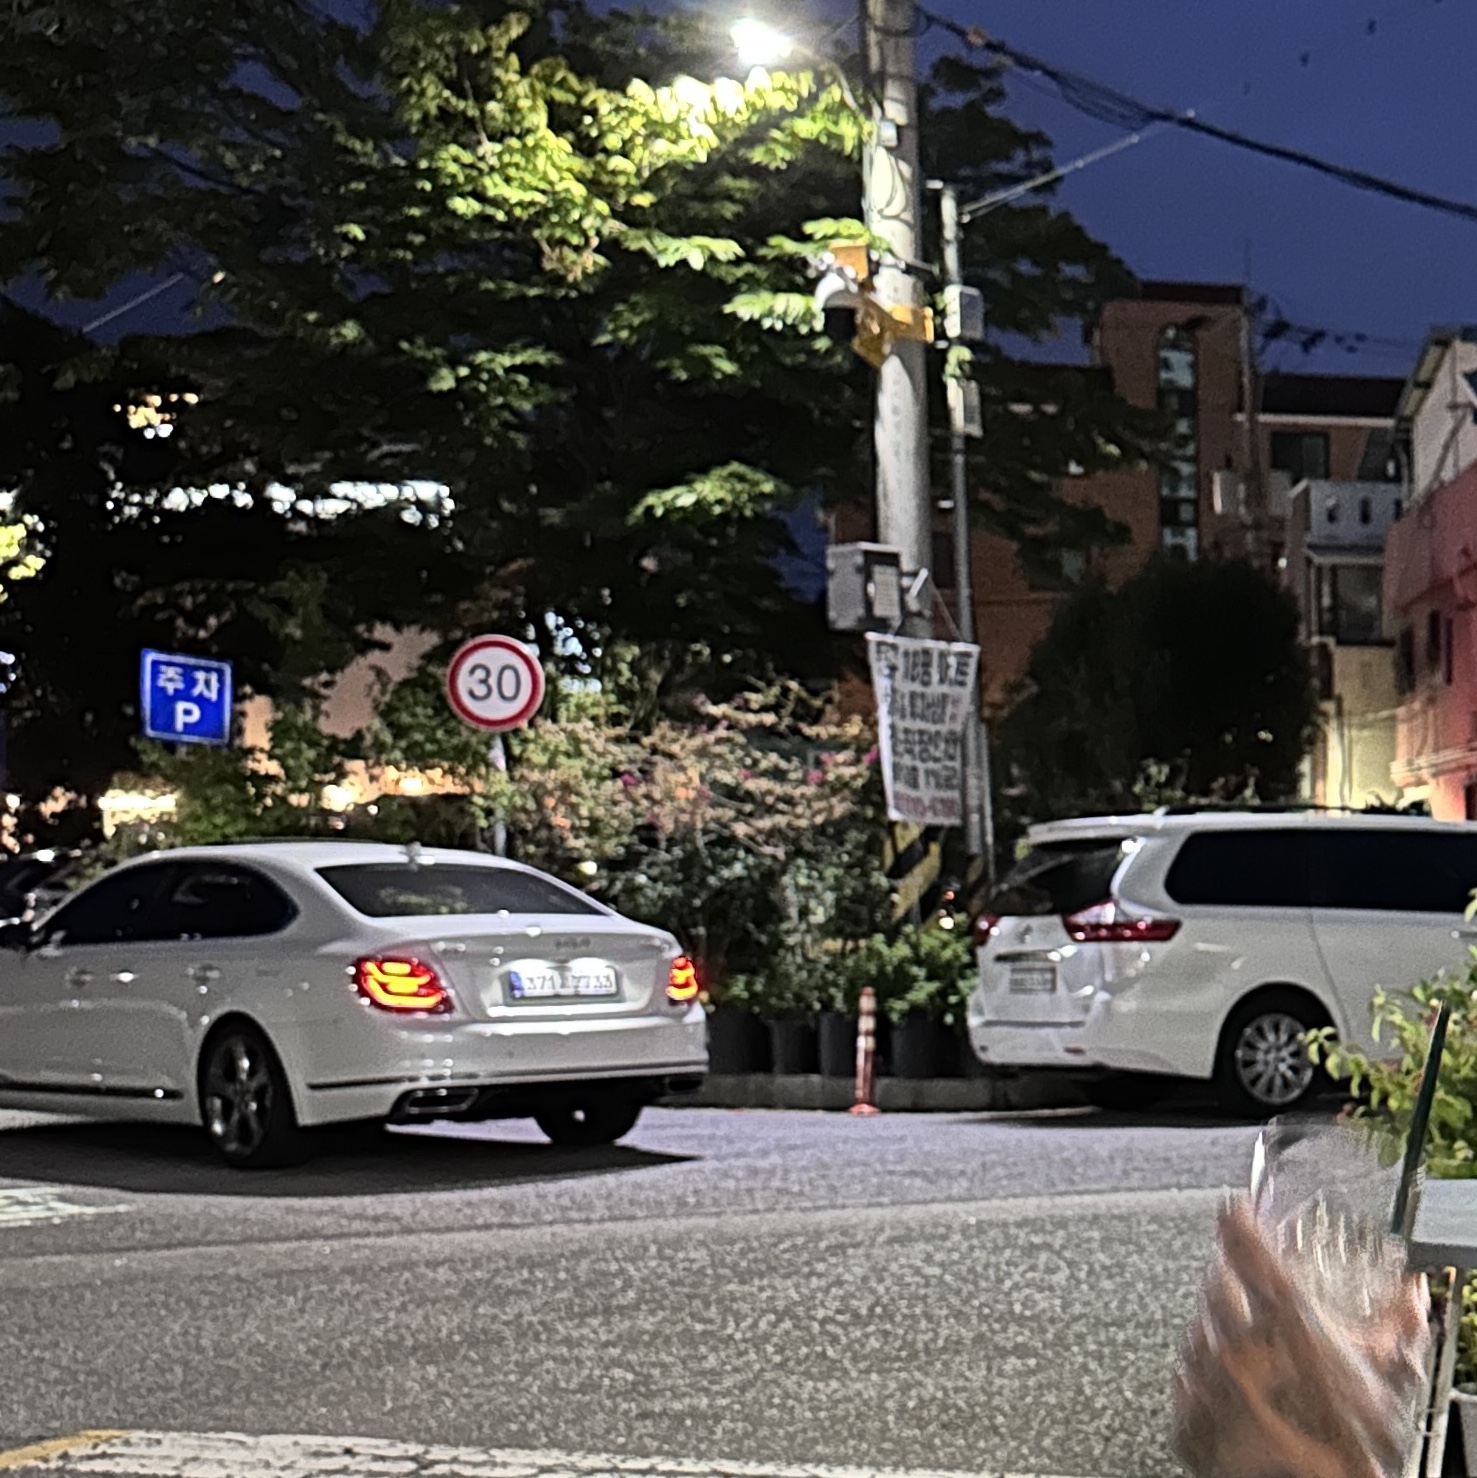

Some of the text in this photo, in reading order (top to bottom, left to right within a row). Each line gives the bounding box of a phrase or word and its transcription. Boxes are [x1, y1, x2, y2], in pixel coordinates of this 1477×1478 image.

[157, 664, 220, 702] 주차
[468, 663, 521, 702] 30
[175, 700, 201, 732] P
